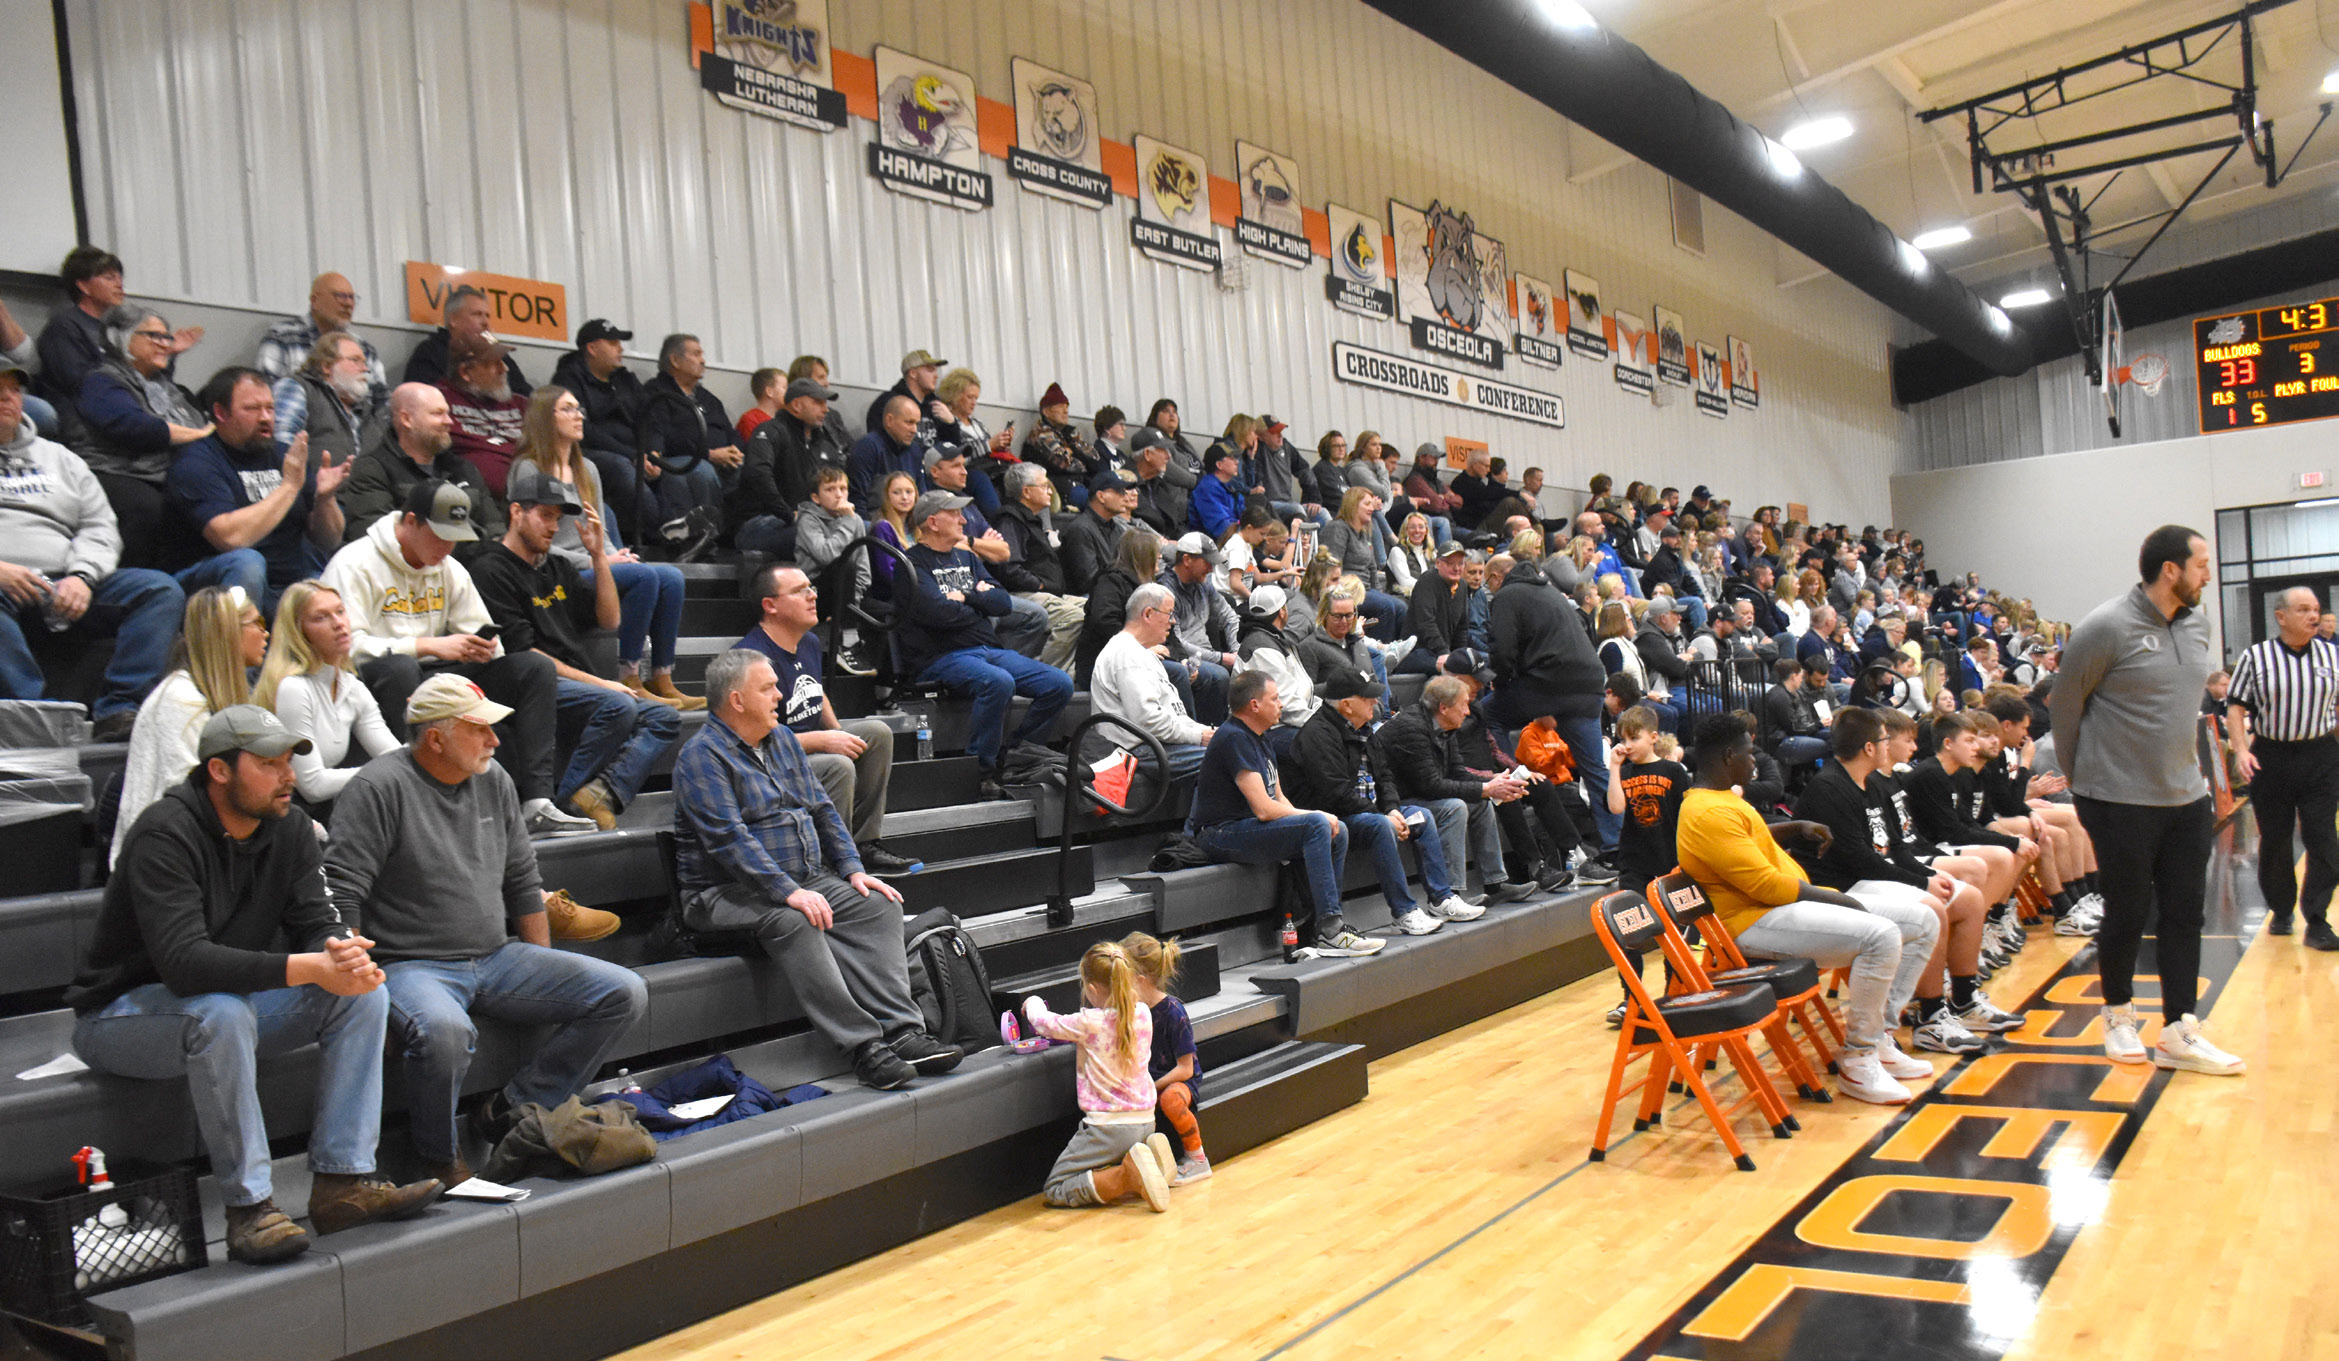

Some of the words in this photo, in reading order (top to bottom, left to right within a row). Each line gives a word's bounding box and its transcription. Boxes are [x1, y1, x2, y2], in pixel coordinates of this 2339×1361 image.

[734, 63, 817, 101] NEBRASKA
[735, 81, 817, 117] LUTHERAN
[878, 151, 986, 199] HAMPTON
[1013, 156, 1056, 180] CROSS
[1059, 169, 1108, 195] COUNTY
[1135, 224, 1168, 246] EAST
[1172, 236, 1219, 260] BUTLER
[1239, 223, 1267, 246] HIGH
[1269, 234, 1309, 259] PLAINS
[1346, 281, 1375, 298] SHELBY
[1365, 299, 1383, 312] CITY
[1427, 326, 1492, 363] OSCEOLA
[1520, 338, 1558, 361] GILTNER
[2203, 342, 2262, 363] BULLDOGS
[2288, 341, 2321, 352] PERIOD
[2220, 358, 2256, 387] 33
[2299, 352, 2315, 373] 3
[1346, 351, 1449, 395] CROSSROADS
[1477, 384, 1558, 421] CONFERENCE
[1617, 367, 1652, 387] DORCHESTER
[2212, 390, 2236, 406] FLS
[2274, 381, 2307, 397] PLYR
[2251, 402, 2268, 423] 5
